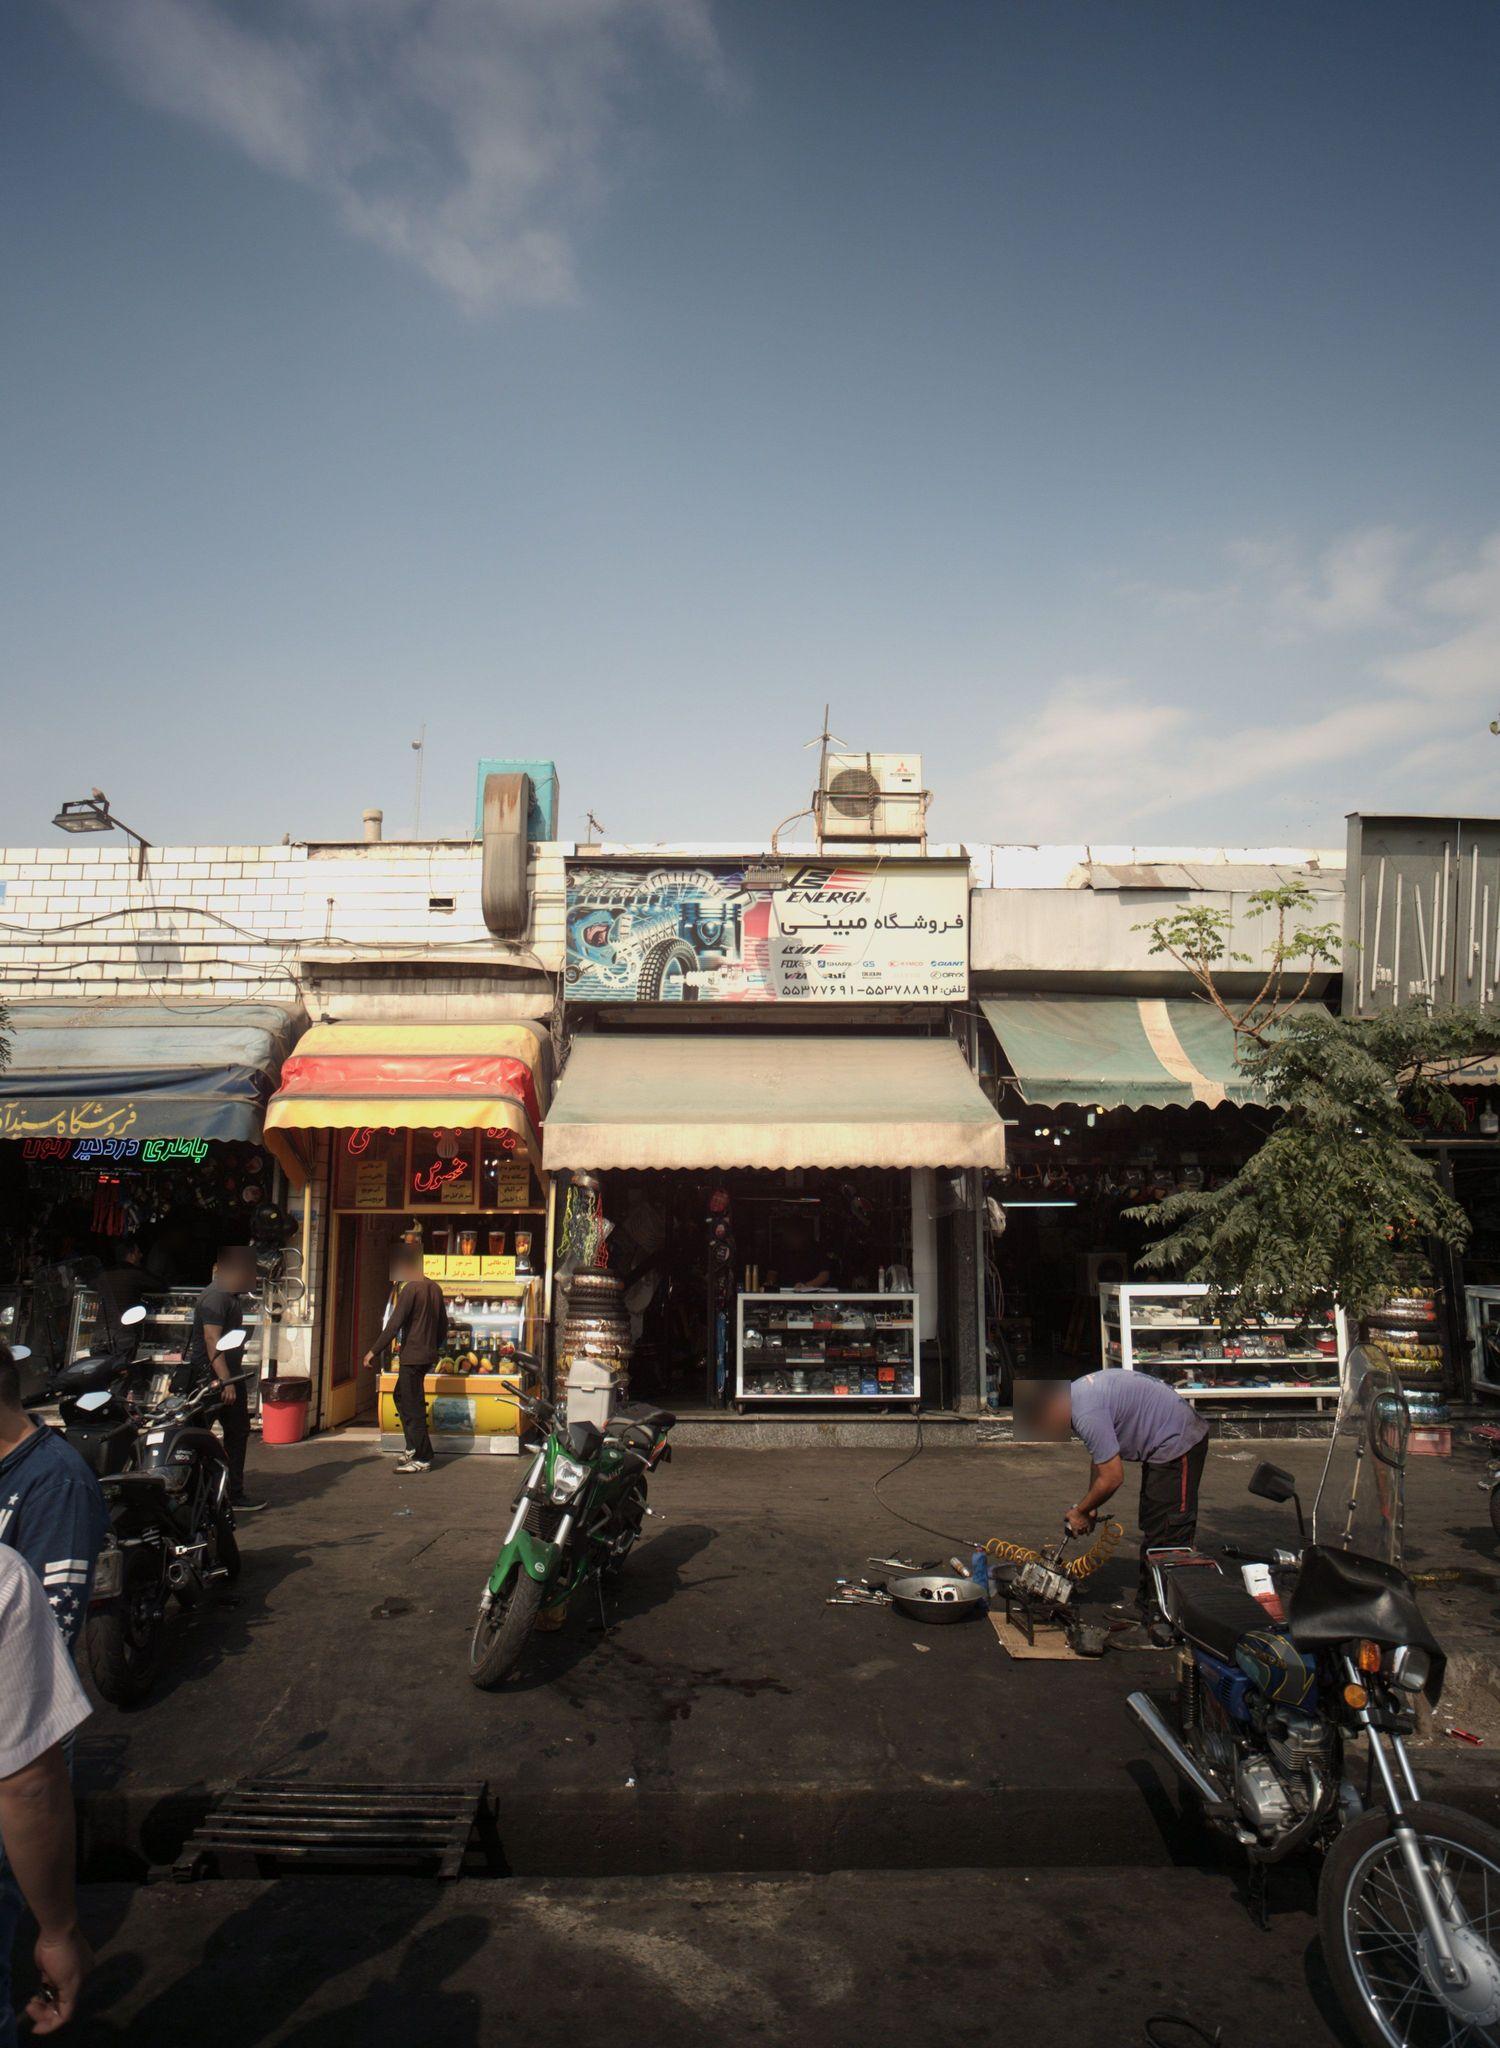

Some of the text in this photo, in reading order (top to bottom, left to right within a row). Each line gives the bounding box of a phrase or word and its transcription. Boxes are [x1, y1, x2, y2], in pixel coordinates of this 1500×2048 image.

[786, 891, 866, 904] ENERGI
[780, 913, 964, 936] فروشگاه مبینی
[58, 1101, 137, 1136] فروشگاه
[142, 1137, 209, 1163] باطری
